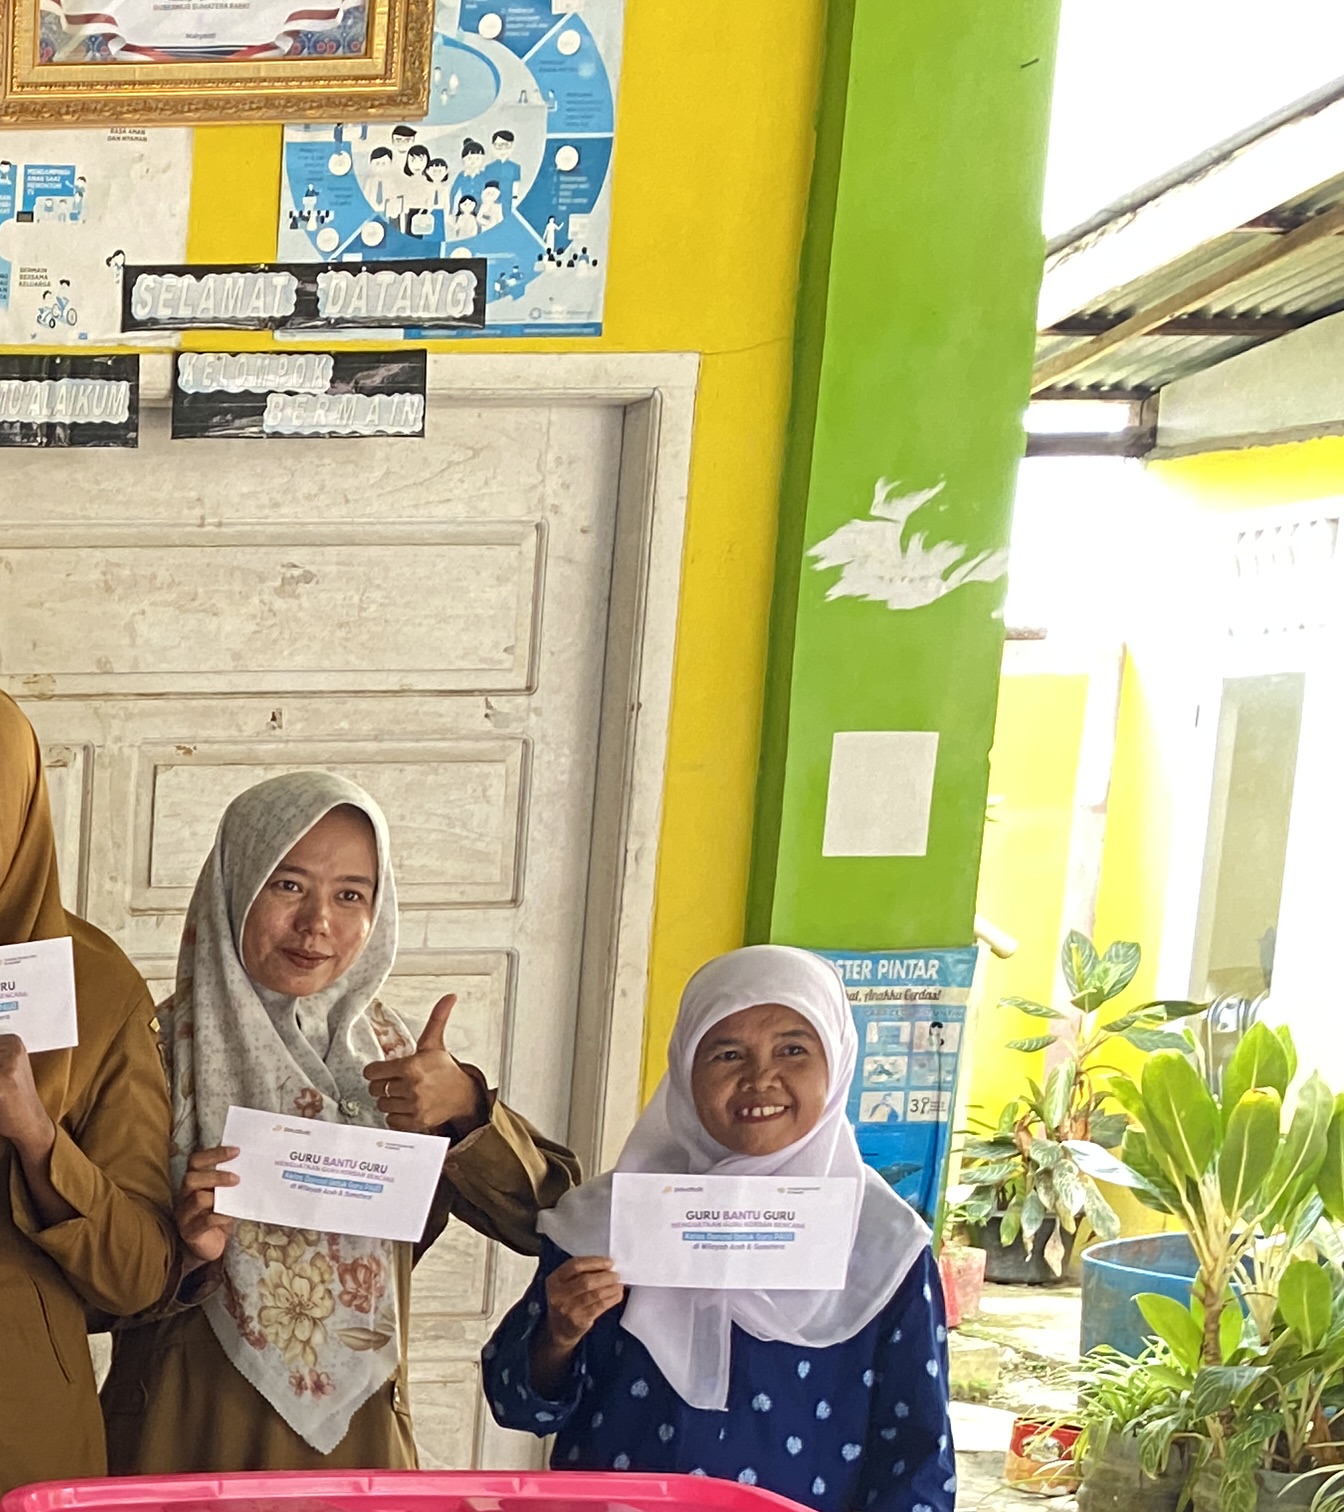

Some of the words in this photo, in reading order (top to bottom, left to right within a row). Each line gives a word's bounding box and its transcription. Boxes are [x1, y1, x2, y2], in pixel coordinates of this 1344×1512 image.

[136, 273, 289, 318] SELAMAT
[327, 274, 469, 317] DATANG
[181, 355, 328, 389] KELOMPOK
[266, 396, 421, 430] BERMAIN
[836, 960, 871, 980] STER
[877, 959, 939, 979] PINTAR
[289, 1151, 321, 1164] GURU
[322, 1155, 357, 1170] BANTU
[359, 1160, 388, 1174] GURU
[685, 1210, 720, 1220] GURU
[722, 1210, 761, 1220] BANTU
[763, 1210, 796, 1221] GURU
